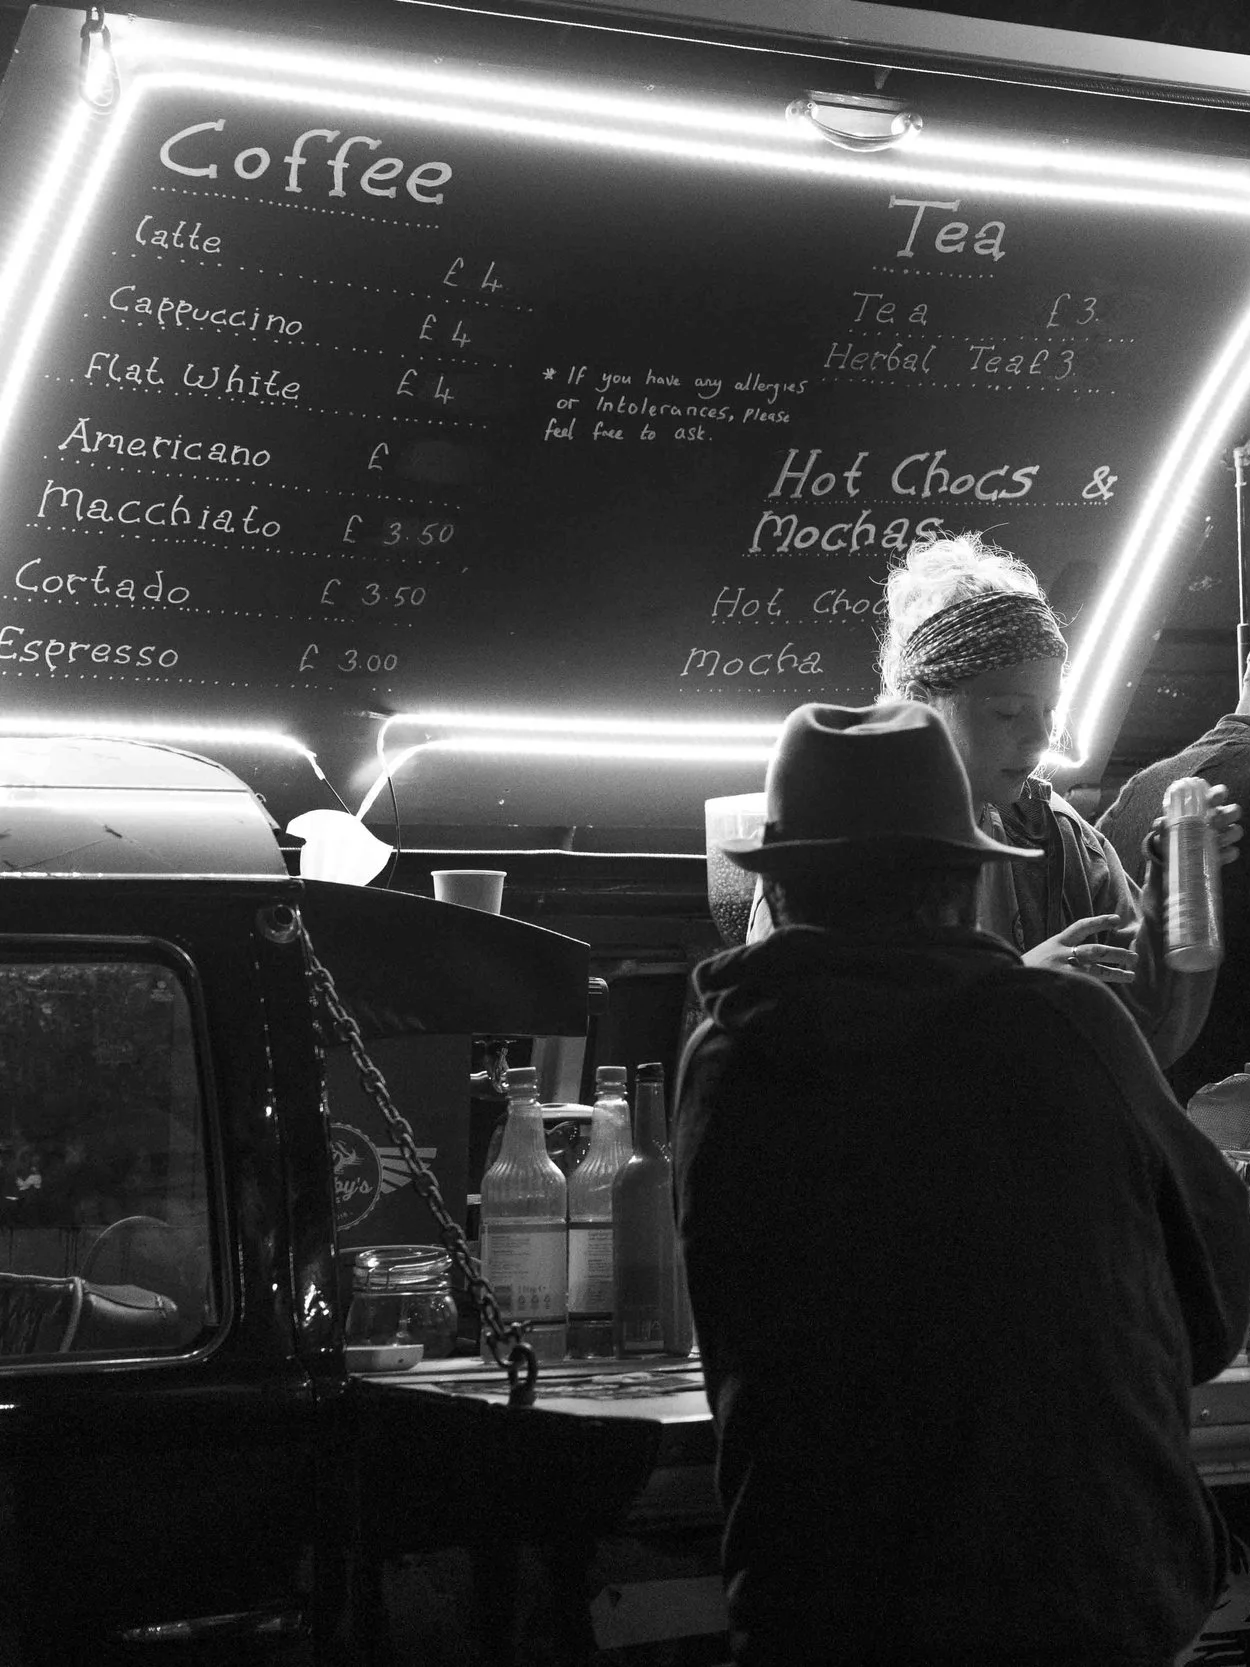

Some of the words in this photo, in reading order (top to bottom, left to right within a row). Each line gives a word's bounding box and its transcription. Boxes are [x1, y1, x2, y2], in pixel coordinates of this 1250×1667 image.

[158, 118, 454, 205] Coffee
[888, 193, 1007, 262] Tea
[109, 284, 303, 337] Cappuccino
[852, 290, 928, 327] Tea
[83, 350, 165, 386] Flat
[183, 362, 302, 402] White
[823, 342, 937, 375] Herbal
[556, 397, 580, 410] or
[567, 365, 588, 385] If
[595, 373, 632, 393] you
[645, 368, 681, 387] have
[694, 376, 723, 400] any
[734, 371, 809, 405] allergies
[57, 417, 271, 468] Americano
[543, 417, 577, 441] feel
[640, 423, 656, 441] to
[767, 447, 869, 500] Hot
[890, 449, 1041, 502] Chocs
[1080, 464, 1120, 502] &
[36, 479, 282, 539] Macchiato
[14, 556, 191, 605] Cortado
[711, 585, 784, 618] Hot
[0, 625, 180, 672] Espresso
[679, 642, 824, 678] Mocha
